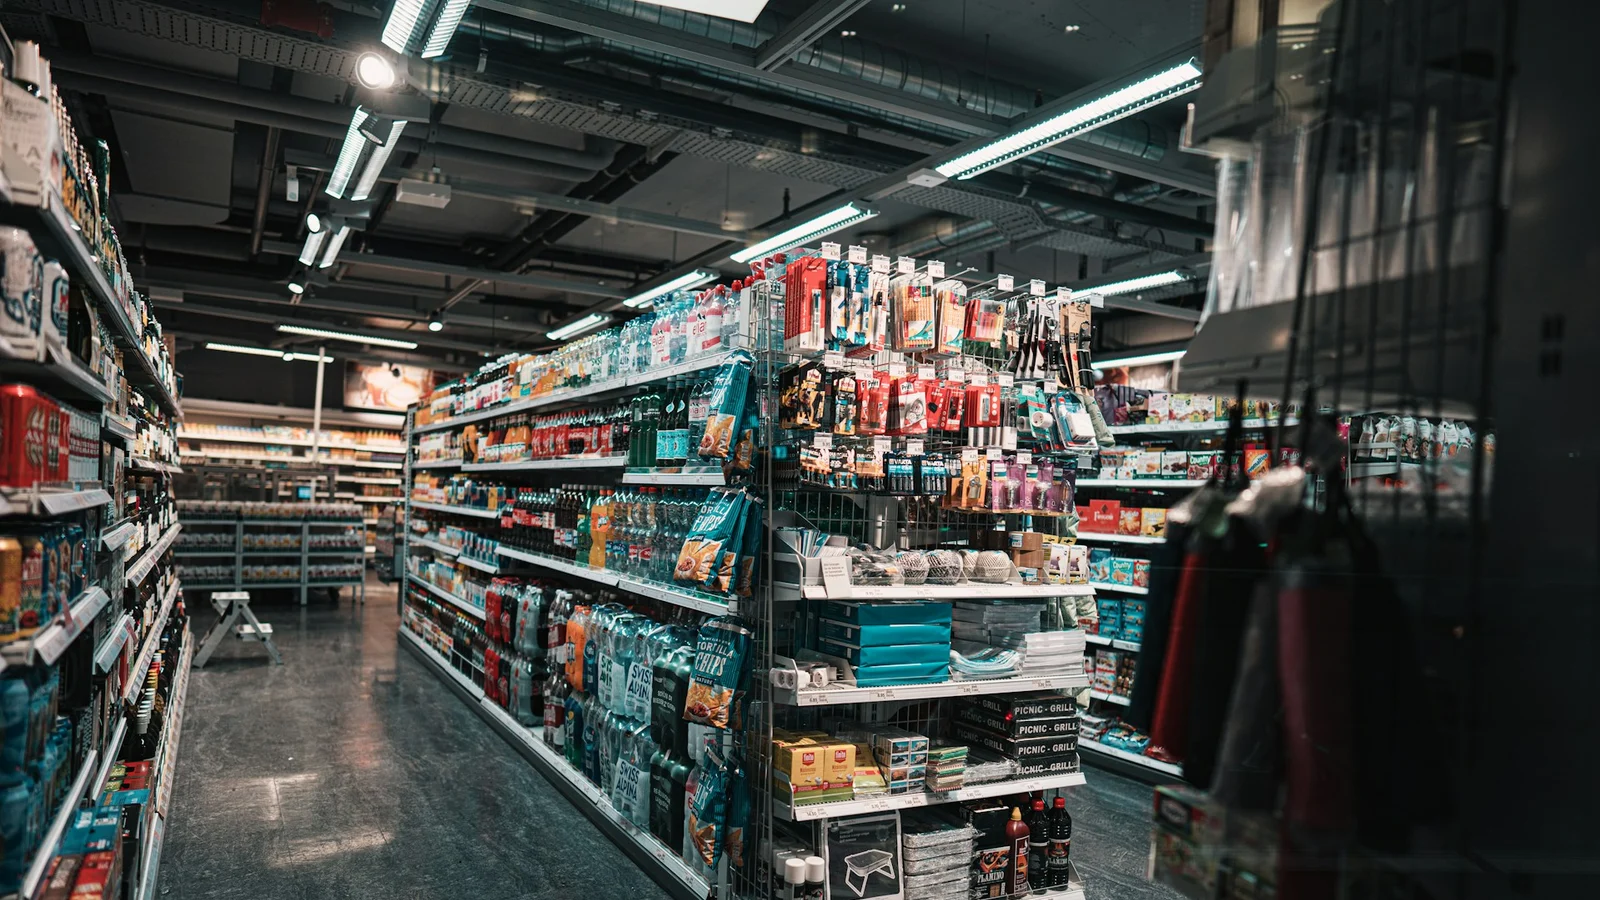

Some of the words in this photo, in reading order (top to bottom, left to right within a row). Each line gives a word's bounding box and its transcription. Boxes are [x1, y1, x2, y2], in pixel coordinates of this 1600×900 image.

[1189, 455, 1212, 466] Country
[1112, 561, 1132, 570] Country
[696, 640, 735, 659] TORTILLA
[694, 651, 728, 677] CHIPS
[696, 676, 714, 686] NATURE
[627, 679, 650, 702] ALPIN
[982, 699, 1002, 713] GRILL
[1014, 705, 1043, 715] PICNIC
[1049, 703, 1074, 713] GRILL
[960, 710, 981, 723] PICNIC
[987, 718, 1007, 731] GRILL
[1019, 724, 1048, 735] PICNIC
[1053, 722, 1077, 732] GRILL
[957, 727, 979, 742] PICNIC
[984, 738, 1004, 752] GRILL
[1018, 744, 1046, 755] PICNIC
[1052, 742, 1075, 752] GRILL
[619, 760, 640, 785] SWISS
[1016, 764, 1044, 775] PICNIC
[1049, 761, 1074, 771] GRILL
[615, 777, 638, 801] ALPINA
